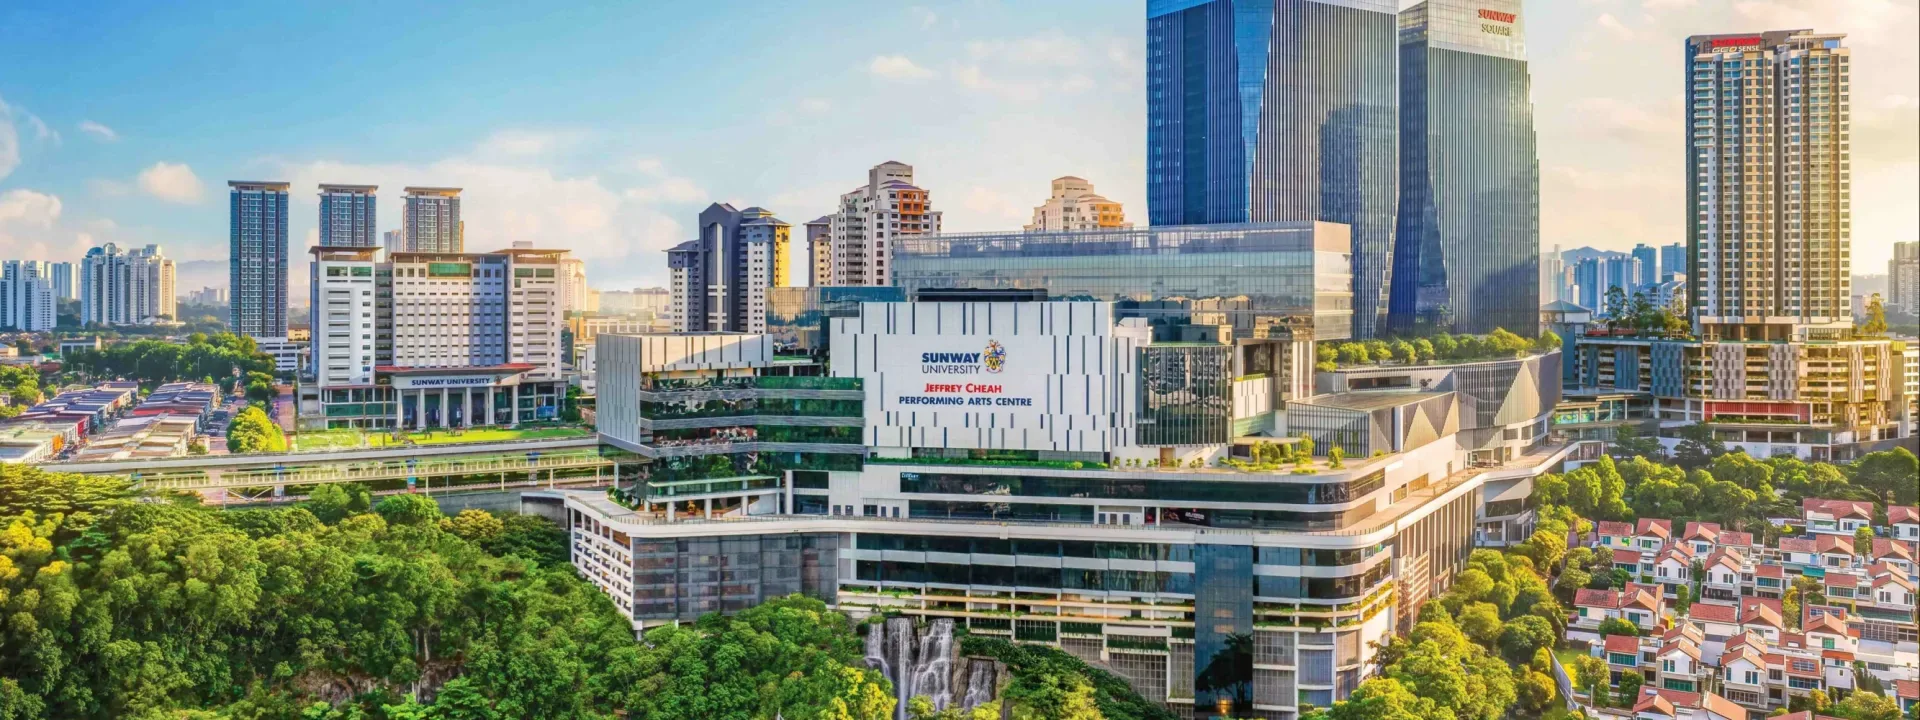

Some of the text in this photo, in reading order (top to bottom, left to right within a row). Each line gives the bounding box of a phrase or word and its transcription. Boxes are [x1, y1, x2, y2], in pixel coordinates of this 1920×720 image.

[1478, 9, 1517, 23] SUNWAY
[1481, 23, 1512, 36] SQUARE
[922, 352, 981, 363] SUNWAY
[922, 365, 981, 374] UNIVERSITY
[447, 377, 490, 385] UNIVERSITY
[924, 383, 1002, 393] JEFFREY CHEAH
[899, 396, 1032, 406] PERFORMING ARTS CENTRE
